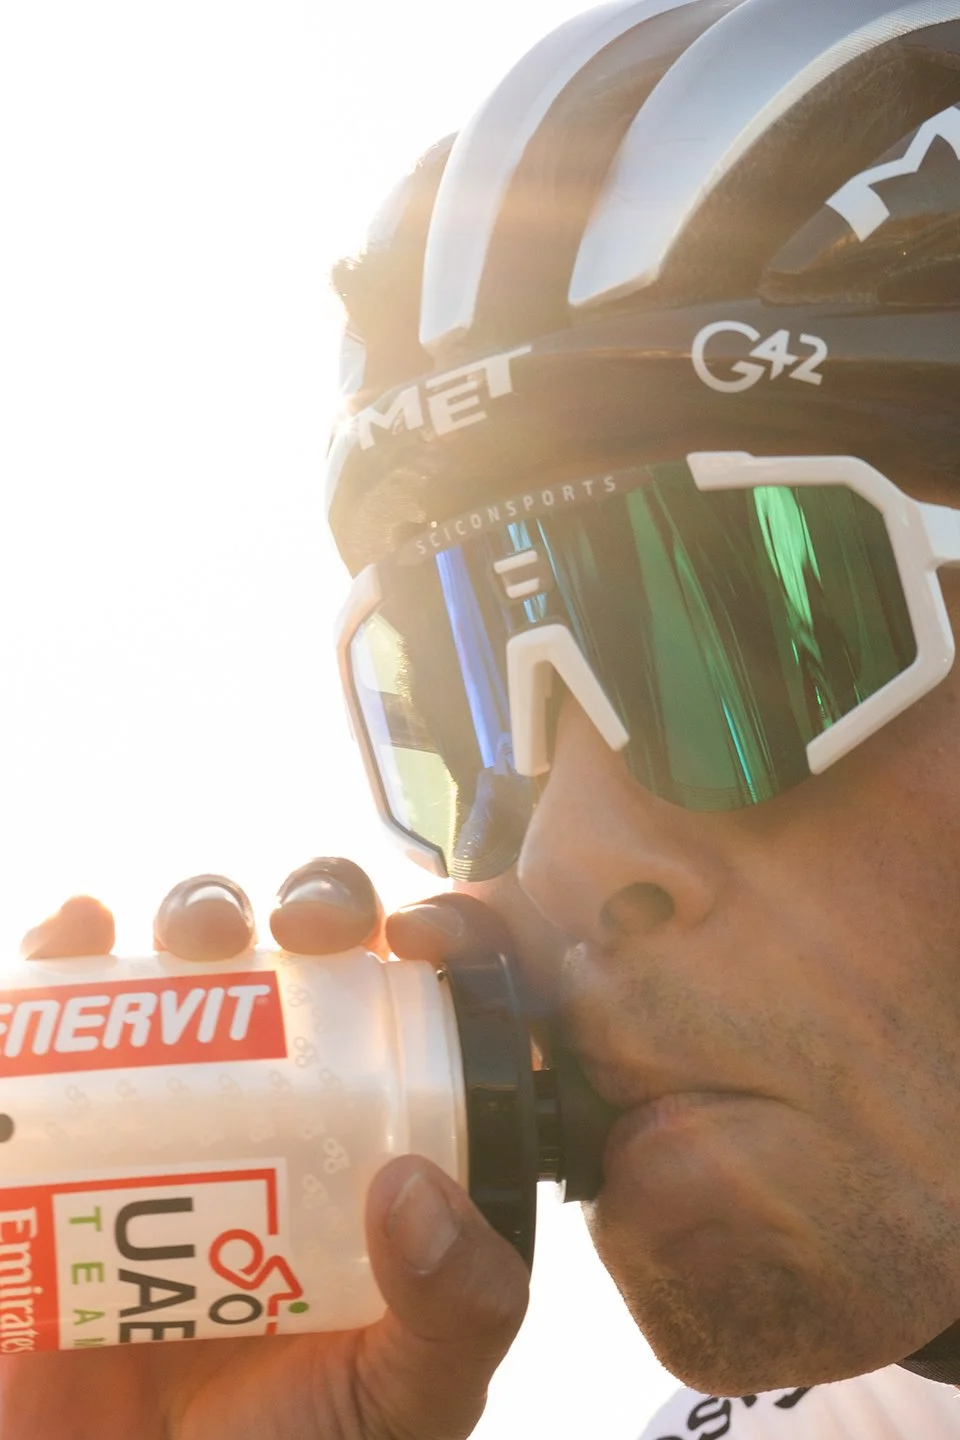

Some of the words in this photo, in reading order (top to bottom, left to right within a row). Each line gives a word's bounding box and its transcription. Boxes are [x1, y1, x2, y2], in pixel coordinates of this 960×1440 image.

[352, 345, 532, 451] MET
[691, 320, 828, 393] G42
[415, 476, 616, 555] SCICONSPORTS
[115, 1197, 196, 1343] UAE
